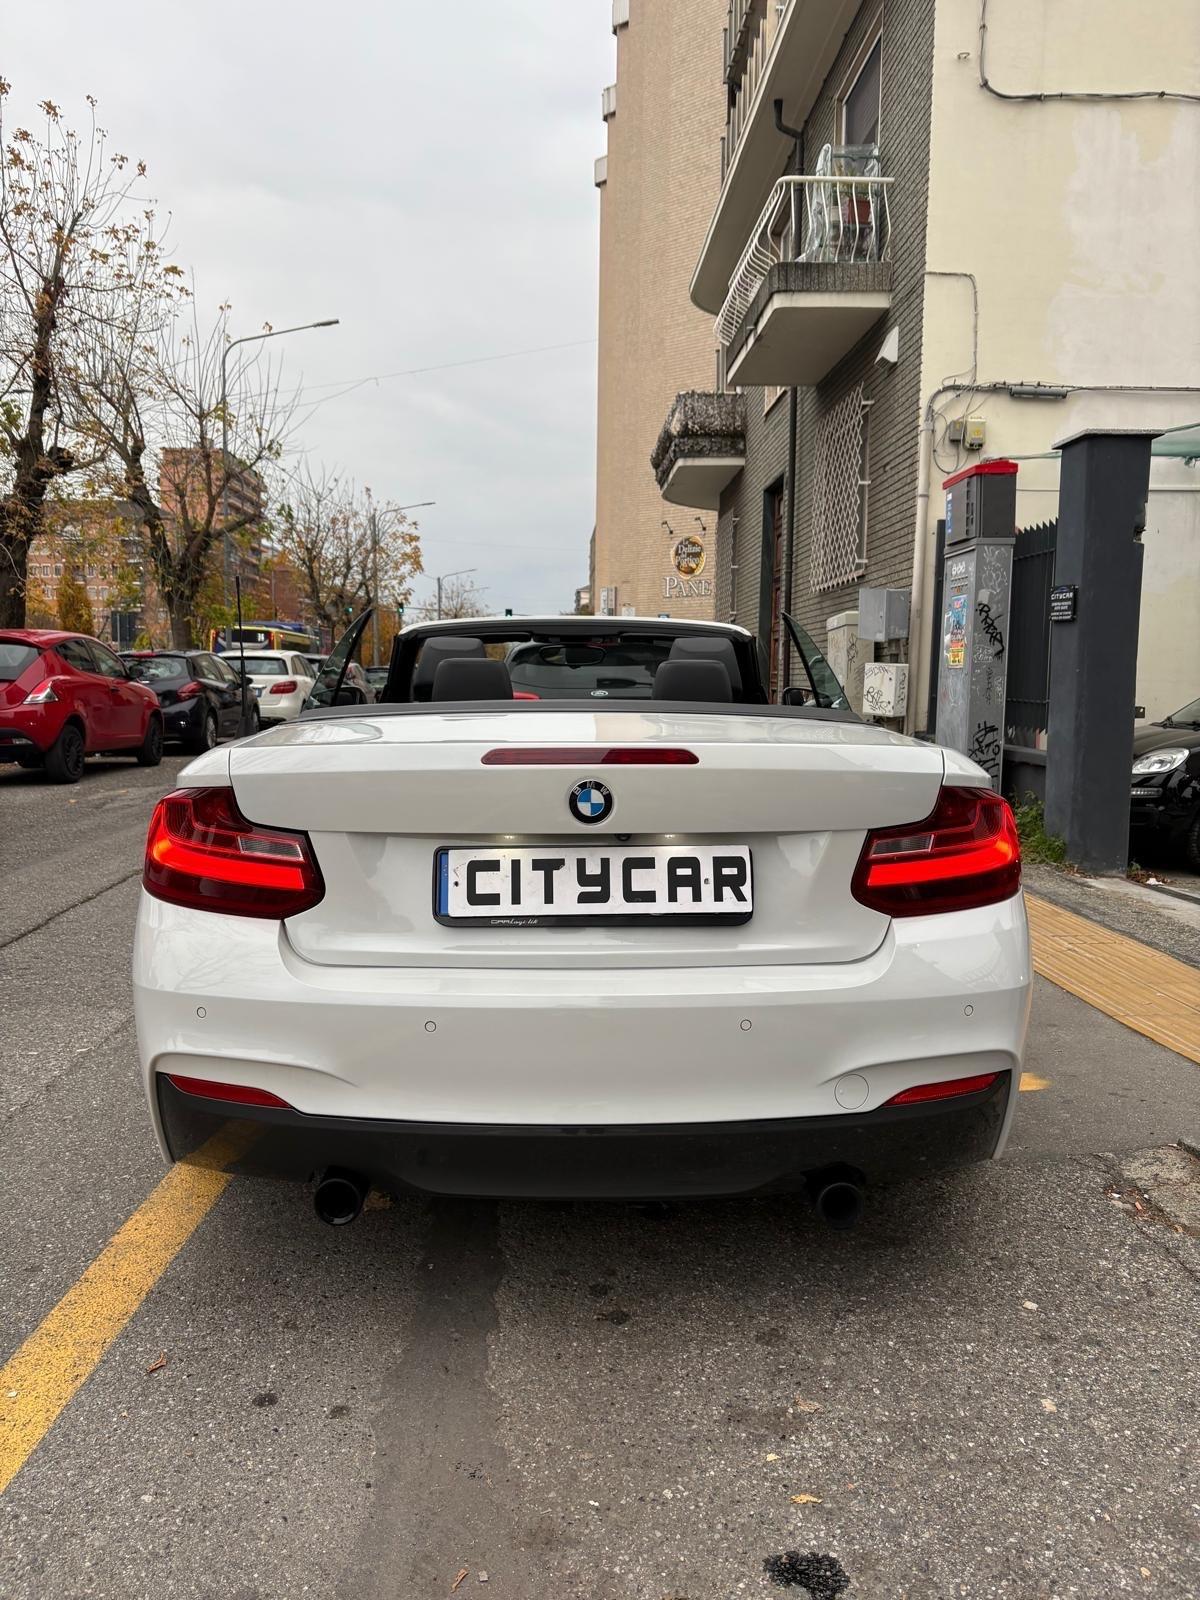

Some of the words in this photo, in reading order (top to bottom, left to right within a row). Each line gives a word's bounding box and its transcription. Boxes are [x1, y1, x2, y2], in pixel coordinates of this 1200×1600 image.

[663, 576, 712, 598] PANE
[572, 781, 609, 795] BMW
[466, 856, 748, 906] CITYCAR
